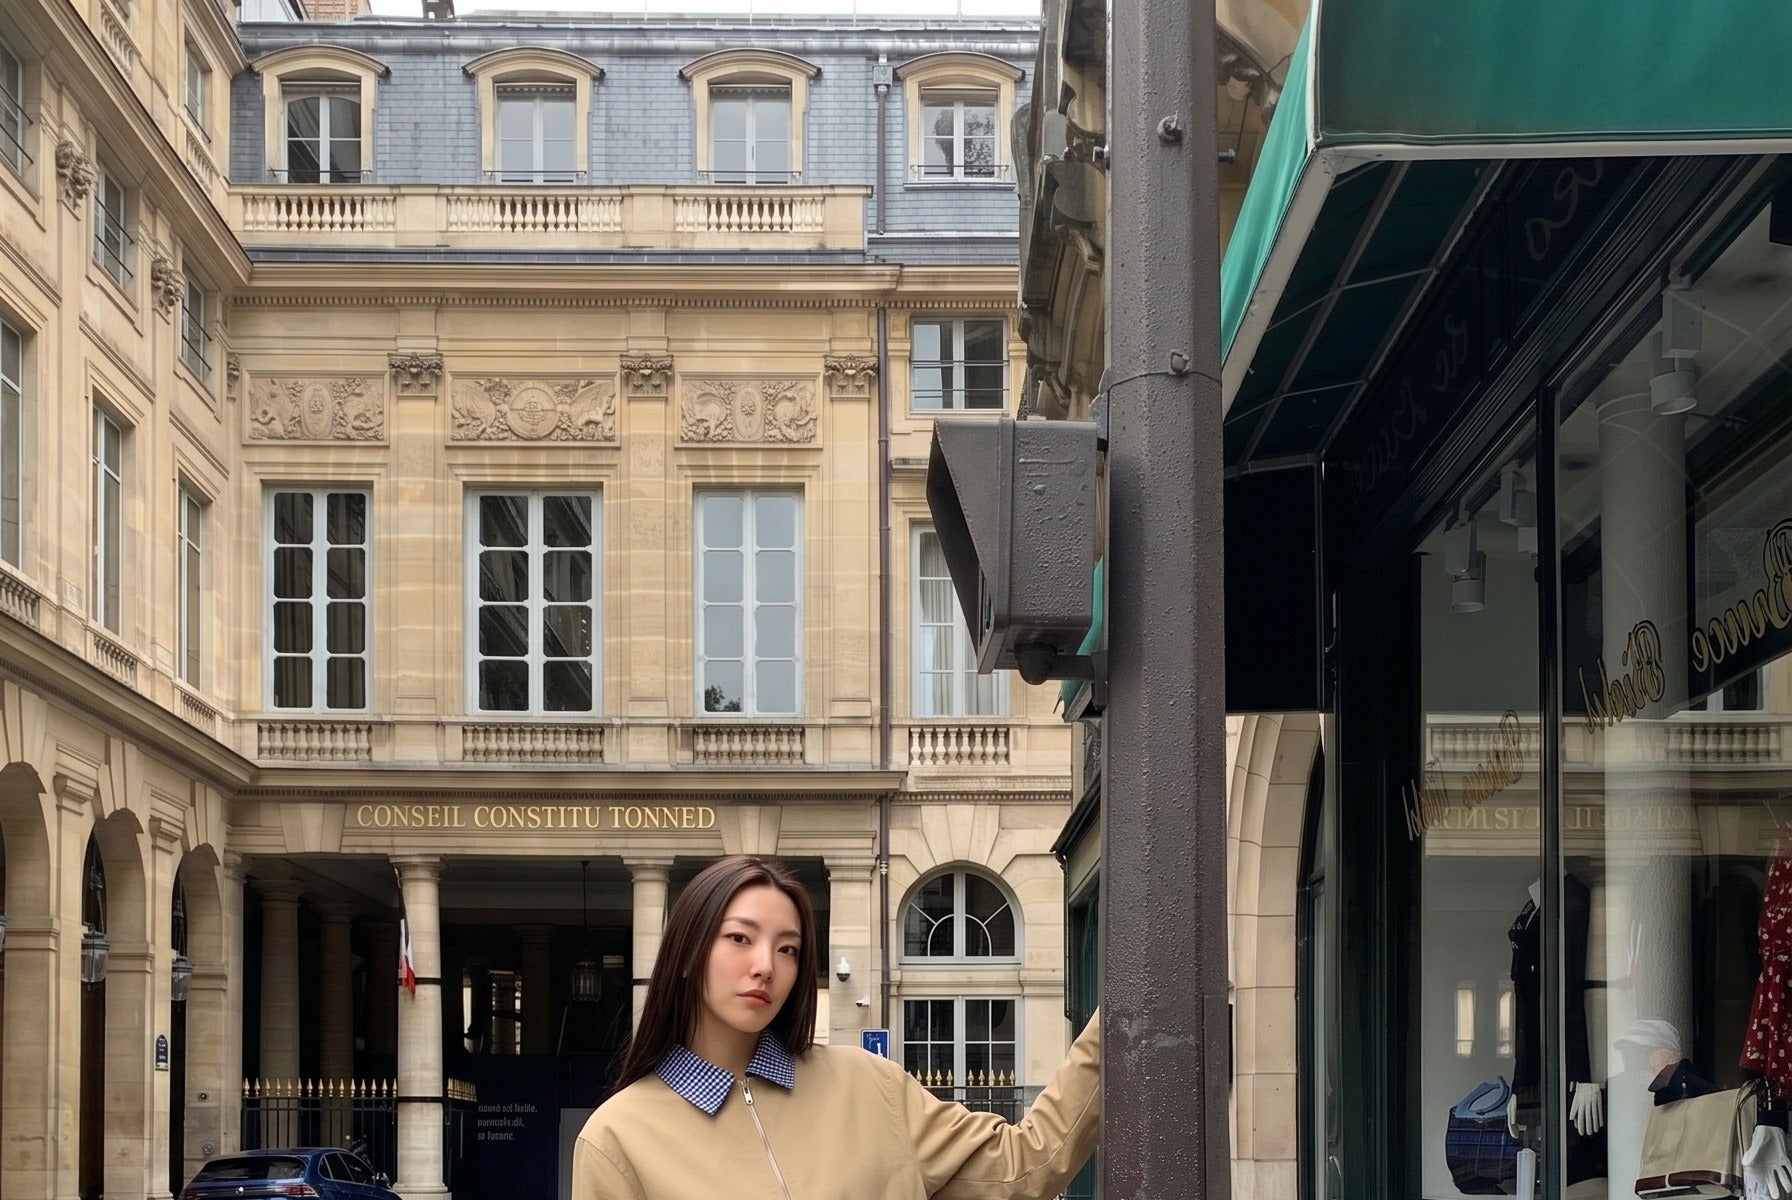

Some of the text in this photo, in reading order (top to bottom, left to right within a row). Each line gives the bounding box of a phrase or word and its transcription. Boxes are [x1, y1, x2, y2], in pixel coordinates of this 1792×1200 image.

[357, 805, 716, 829] CONSEIL CONSTITU TONNED
